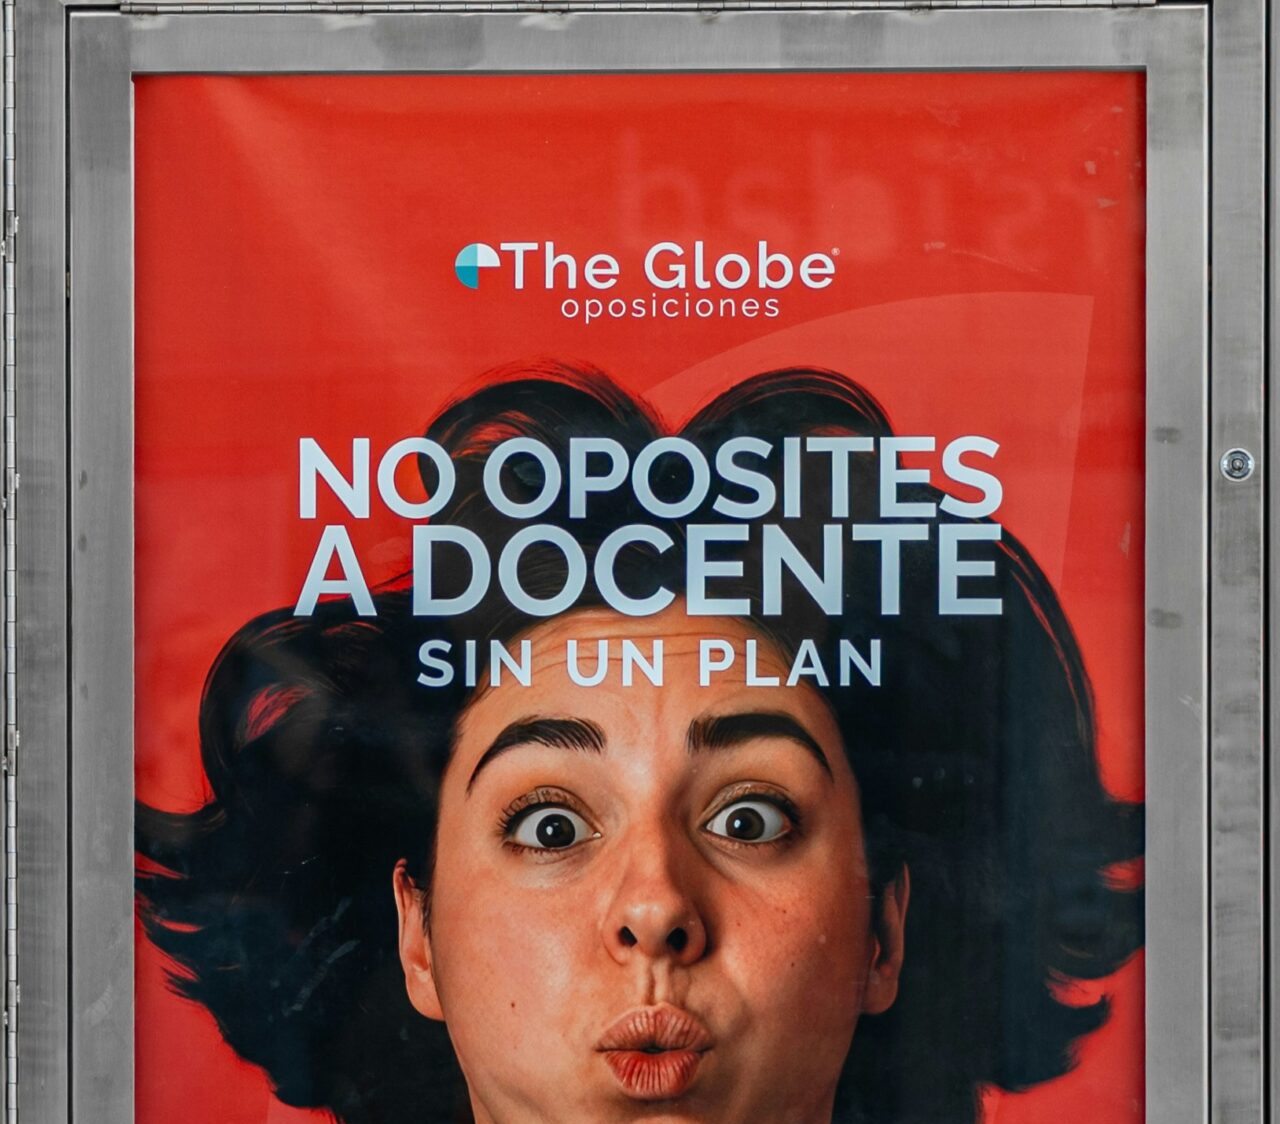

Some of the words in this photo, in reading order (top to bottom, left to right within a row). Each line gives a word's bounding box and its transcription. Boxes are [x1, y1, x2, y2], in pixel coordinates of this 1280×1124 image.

[499, 241, 620, 290] The
[644, 240, 838, 290] Globe
[560, 292, 780, 325] oposiciones
[300, 437, 456, 518] NO
[484, 436, 1003, 518] OPOSITES
[293, 524, 378, 616] A
[412, 523, 1003, 617] DOCENTE
[417, 639, 532, 687] SIN
[566, 639, 664, 687] UN
[699, 639, 881, 687] PLAN
